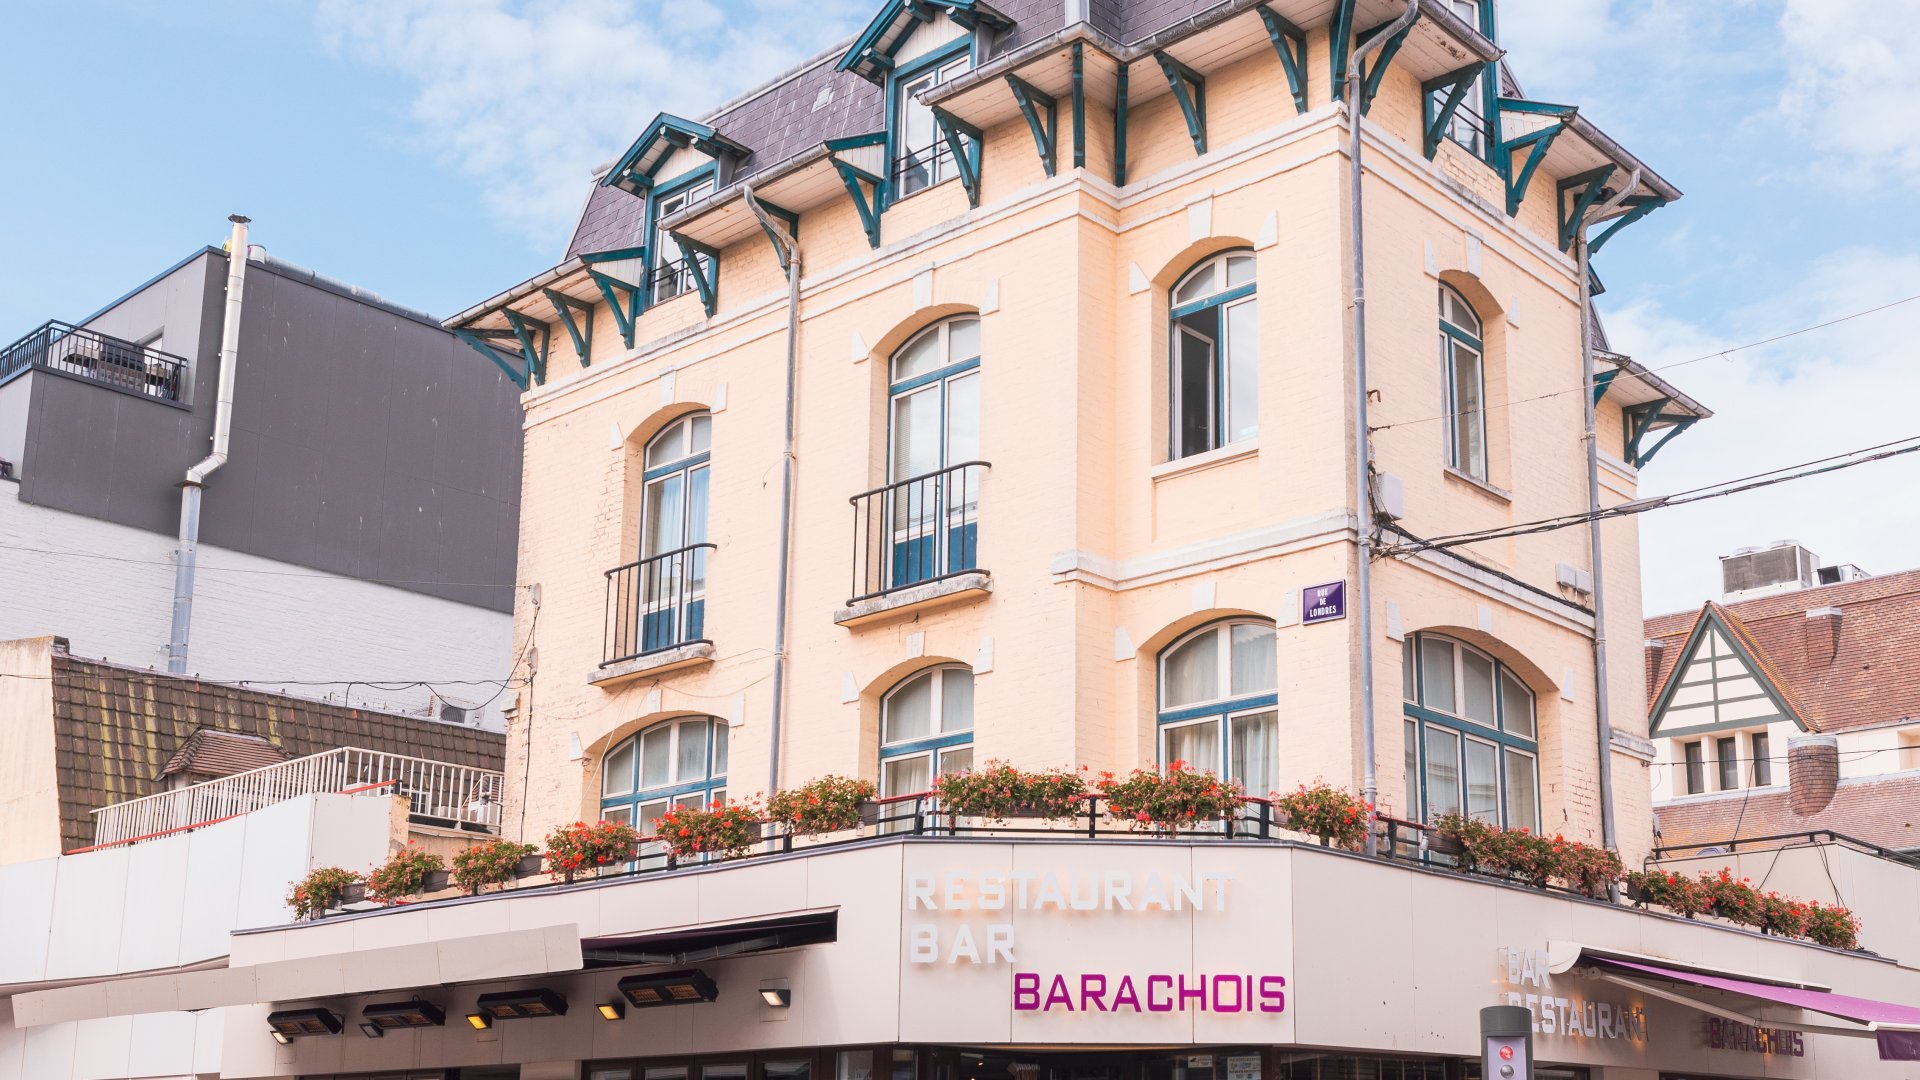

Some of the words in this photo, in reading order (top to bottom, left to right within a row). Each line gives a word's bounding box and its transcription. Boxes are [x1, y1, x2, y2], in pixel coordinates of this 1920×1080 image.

[1309, 605, 1336, 617] LONDRES
[1317, 588, 1328, 597] RUE
[1320, 597, 1326, 605] DE
[907, 871, 1234, 912] RESTAURANT
[909, 923, 1017, 964] BAR
[1507, 944, 1551, 990] BAR
[1013, 972, 1287, 1014] BARACHOIS
